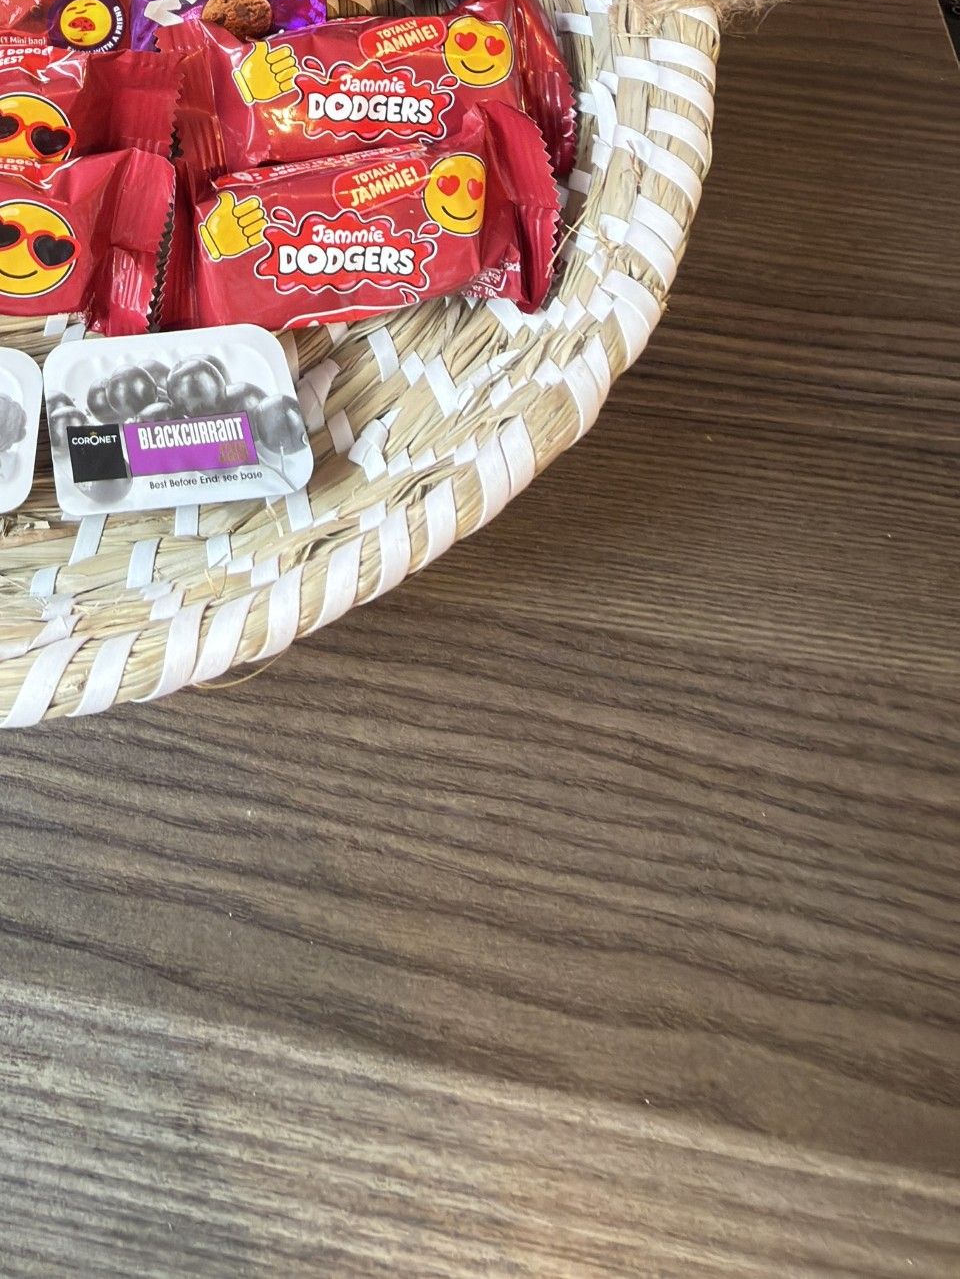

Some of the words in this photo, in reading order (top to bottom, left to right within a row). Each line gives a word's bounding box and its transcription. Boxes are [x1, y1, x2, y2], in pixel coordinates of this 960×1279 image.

[113, 5, 124, 35] FRIEND
[376, 20, 418, 40] TOTALLY
[112, 35, 120, 43] A
[374, 24, 439, 58] JAMMIE!
[340, 72, 406, 94] Jammie
[307, 92, 434, 124] DODGERS
[352, 162, 398, 185] TOTALLY
[350, 166, 420, 207] JAMMIE!
[312, 224, 385, 244] Jammie
[278, 244, 416, 275] DODGERS
[71, 434, 118, 446] CORONET
[149, 480, 168, 490] Best
[170, 477, 198, 488] Before
[200, 476, 221, 485] End:
[222, 473, 238, 482] see
[240, 470, 263, 481] base
